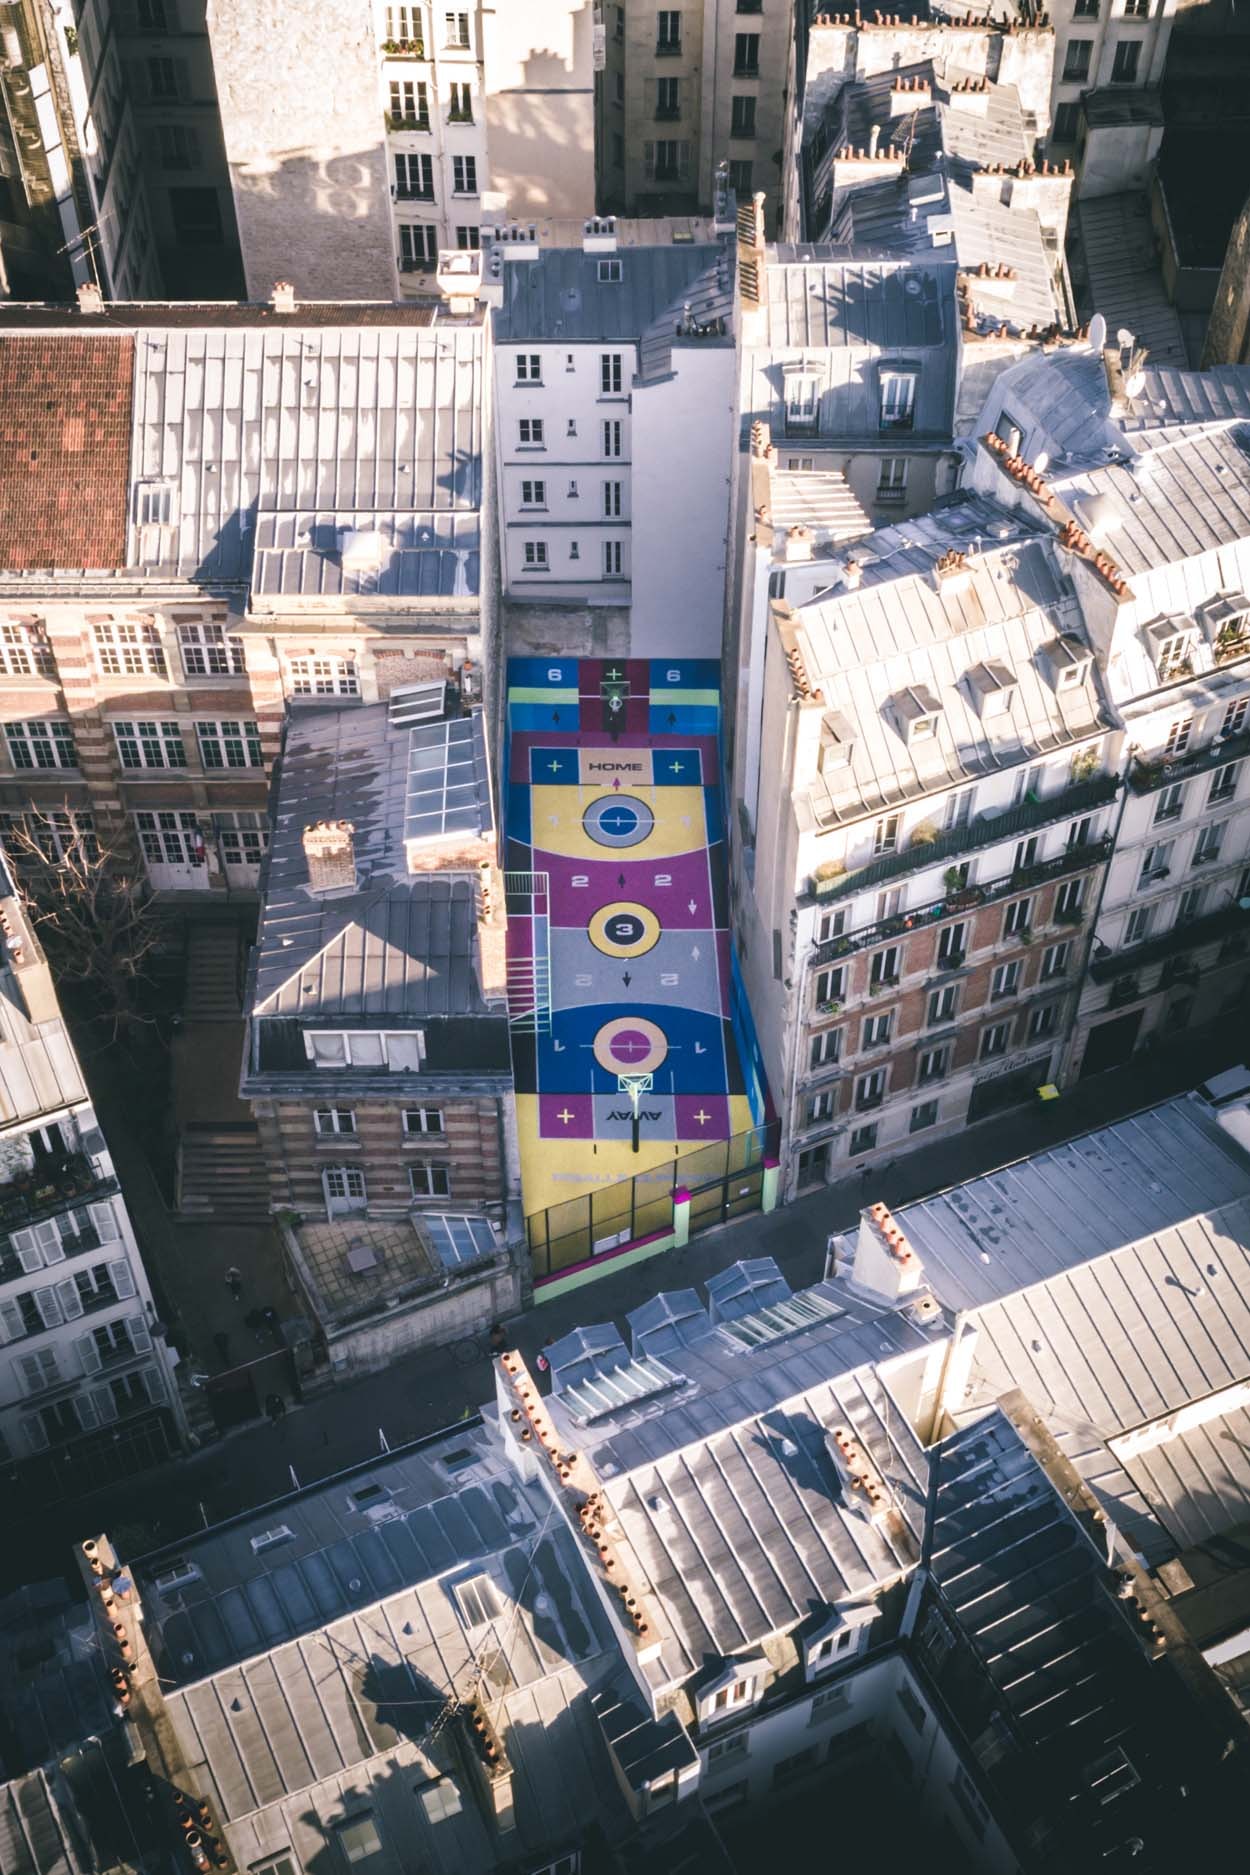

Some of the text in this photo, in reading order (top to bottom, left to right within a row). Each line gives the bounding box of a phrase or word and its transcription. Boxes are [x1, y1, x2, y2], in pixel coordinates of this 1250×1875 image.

[548, 669, 562, 681] 6
[667, 670, 681, 682] 6
[589, 763, 642, 771] HOME
[571, 875, 589, 888] 2
[654, 874, 672, 886] 2
[616, 924, 633, 935] 3
[606, 1111, 662, 1121] AWAY
